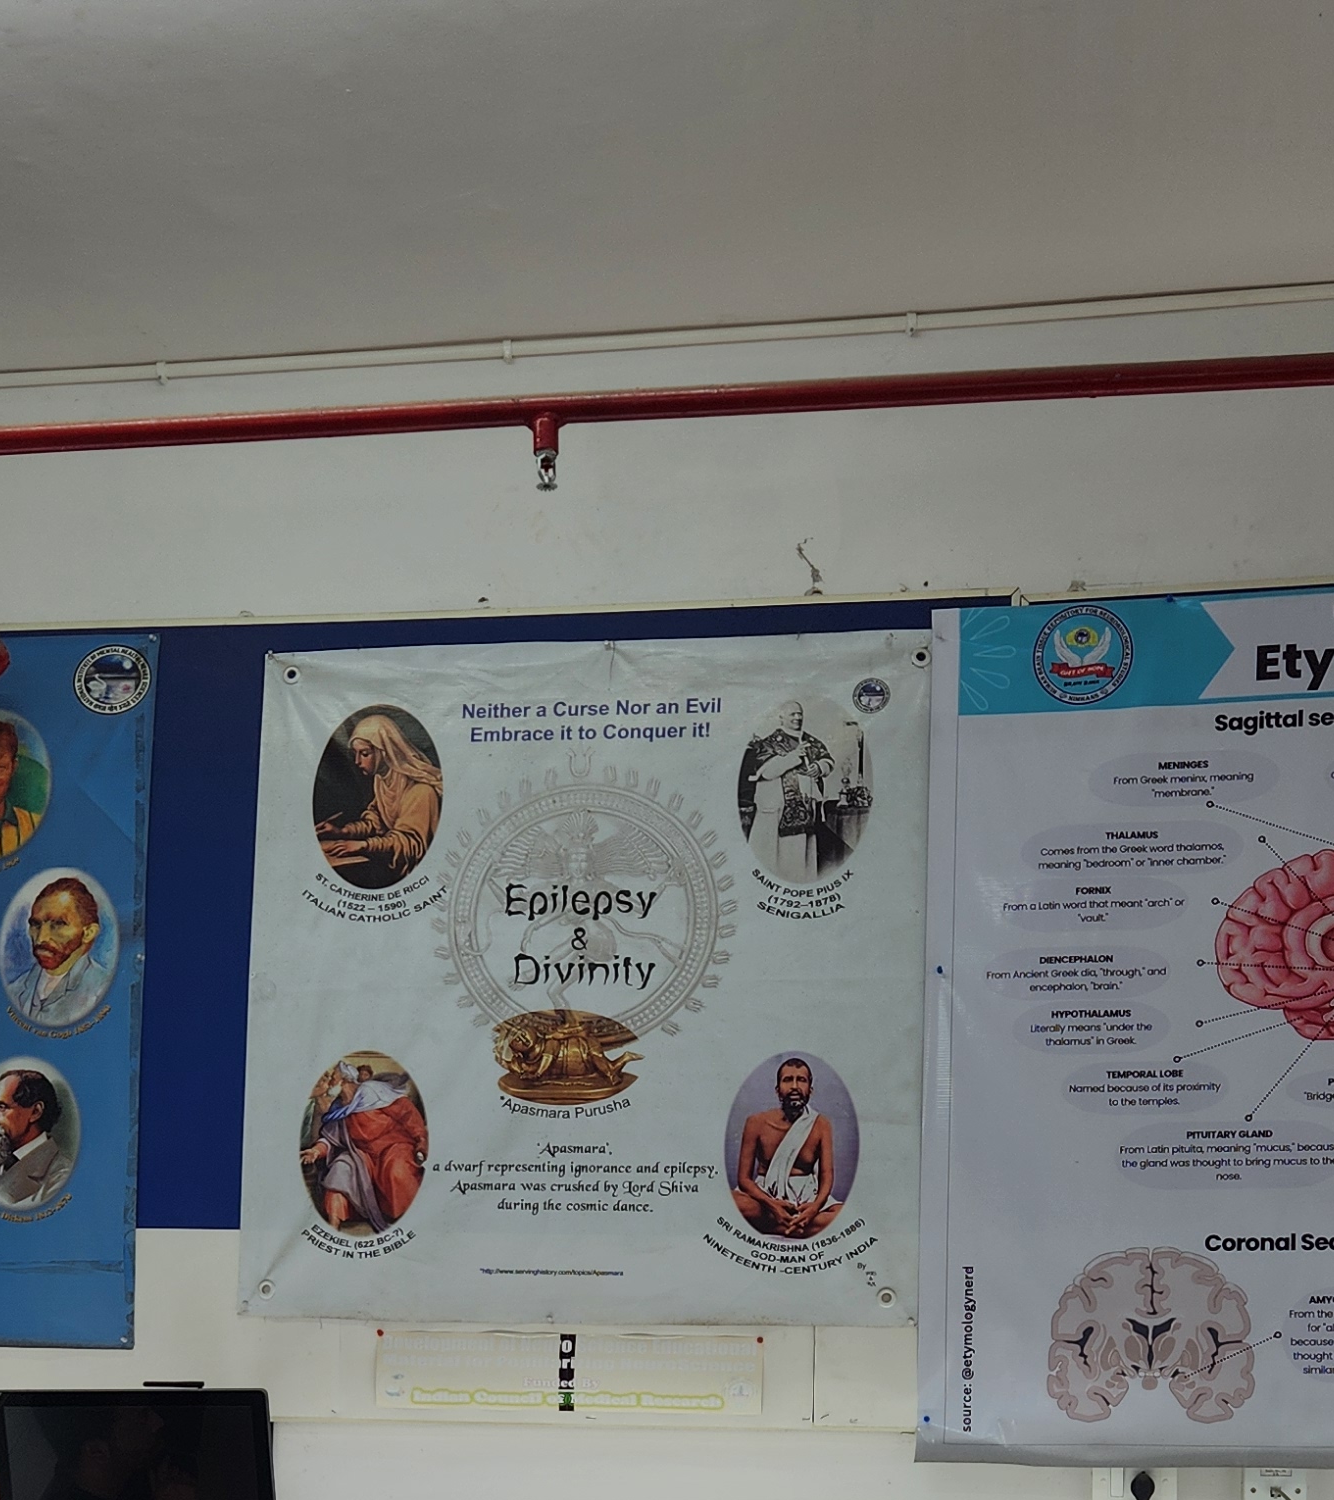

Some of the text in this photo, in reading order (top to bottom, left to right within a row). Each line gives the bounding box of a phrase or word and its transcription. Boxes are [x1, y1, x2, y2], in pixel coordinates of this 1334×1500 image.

[462, 697, 722, 719] Neither a Curse Nor an Evil
[470, 721, 710, 743] Embrace it to Conquer it!
[1214, 709, 1304, 736] Sagittal
[1157, 760, 1209, 771] MENINGES
[1105, 830, 1159, 840] THALAMUS
[315, 872, 430, 901] ST. CATHERINE DE RICCI
[1075, 886, 1112, 896] FORNIX
[504, 882, 658, 922] Epilepsy
[756, 901, 846, 920] SENIGALLIA
[571, 927, 588, 950] &
[1039, 954, 1114, 965] DIENCEPHALON
[513, 952, 656, 991] Divinity
[1051, 1009, 1132, 1019] HYPOTHALAMUS
[574, 1097, 632, 1118] Purusha
[432, 1160, 719, 1179] a dwarf representing ignorance and epilepsy.
[450, 1179, 516, 1195] Apasmara
[520, 1182, 547, 1192] was
[550, 1180, 600, 1193] crushed
[603, 1180, 619, 1197] by
[657, 1180, 699, 1197] Shiva
[497, 1198, 654, 1215] during the cosmic dance.
[1204, 1232, 1297, 1252] Coronal
[961, 1265, 976, 1433] source: @etymologynerd
